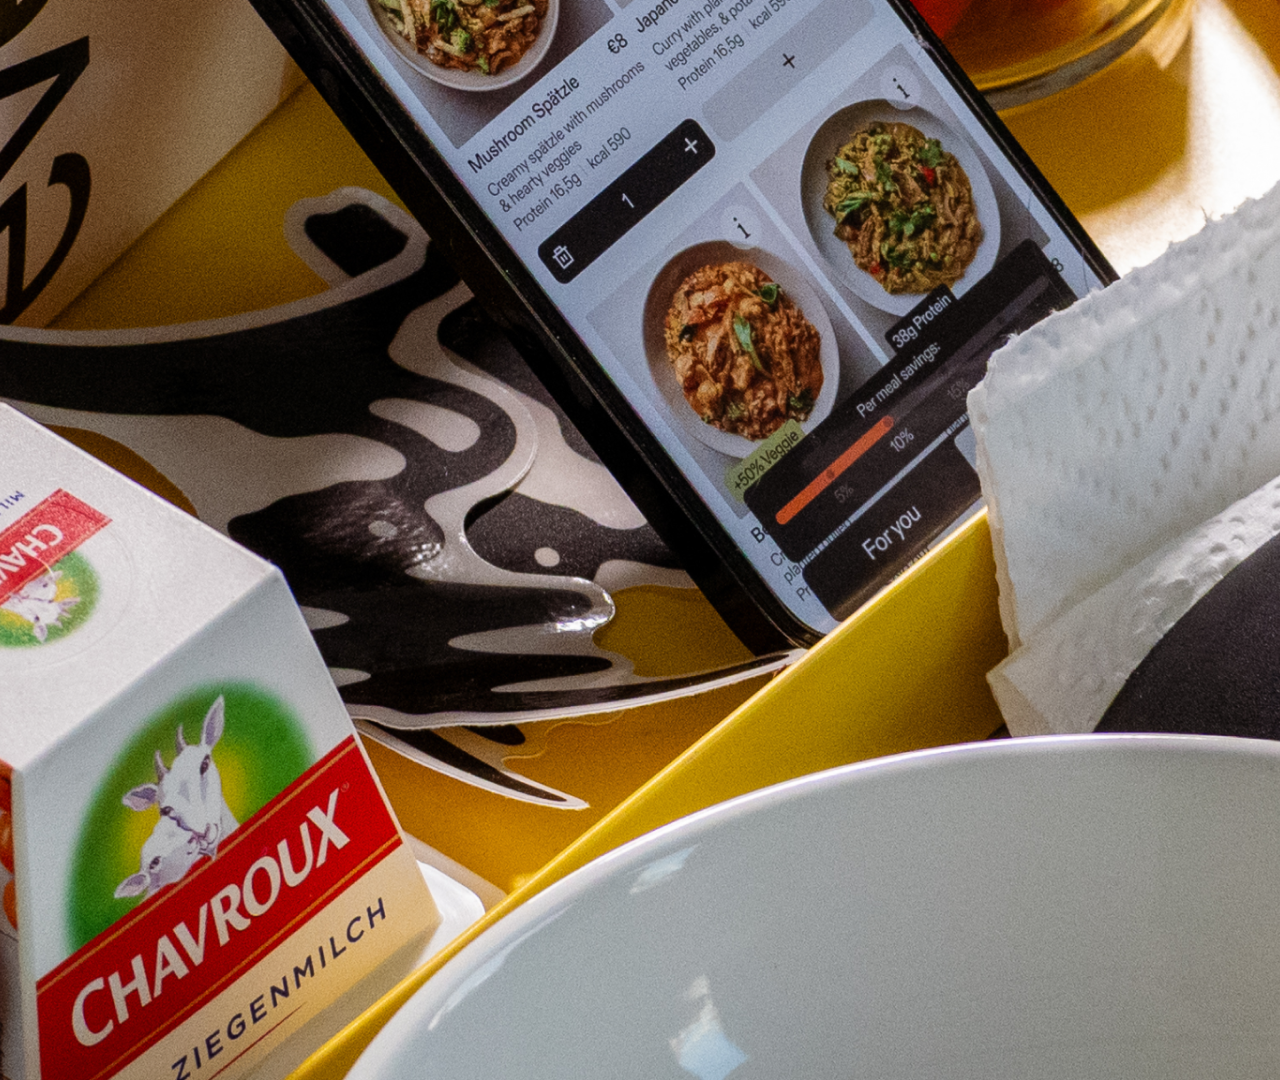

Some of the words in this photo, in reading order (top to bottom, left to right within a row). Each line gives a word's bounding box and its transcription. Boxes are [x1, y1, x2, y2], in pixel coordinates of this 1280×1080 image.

[651, 29, 685, 57] Curry
[681, 6, 709, 38] with
[665, 18, 725, 73] vegetables,
[717, 13, 732, 30] &
[677, 52, 718, 91] Protein
[712, 32, 746, 64] 16,5g
[747, 7, 773, 31] kcal
[467, 113, 536, 174] Mushroom
[531, 74, 581, 121] Spätzle
[607, 32, 629, 55] €8
[487, 163, 528, 198] Creamy
[527, 128, 566, 170] spätzle
[563, 108, 587, 134] with
[585, 61, 645, 116] mushrooms
[499, 198, 513, 214] &
[508, 169, 544, 206] hearty
[541, 140, 583, 180] veggies
[513, 195, 552, 232] Protein
[548, 172, 583, 204] 16,5g
[586, 149, 611, 171] kcal
[607, 126, 632, 152] 590
[621, 193, 635, 210] 1
[891, 322, 918, 349] 38g
[913, 293, 952, 329] Protein
[856, 397, 879, 418] Per
[873, 372, 903, 402] meal
[899, 342, 941, 382] savings:
[733, 458, 766, 492] +50%
[760, 428, 800, 468] Veggie
[889, 427, 915, 453] 10%
[862, 527, 897, 561] For
[889, 505, 922, 541] you
[70, 788, 350, 1047] CHAVROUX
[170, 897, 387, 1080] ZIEGENMILCH
